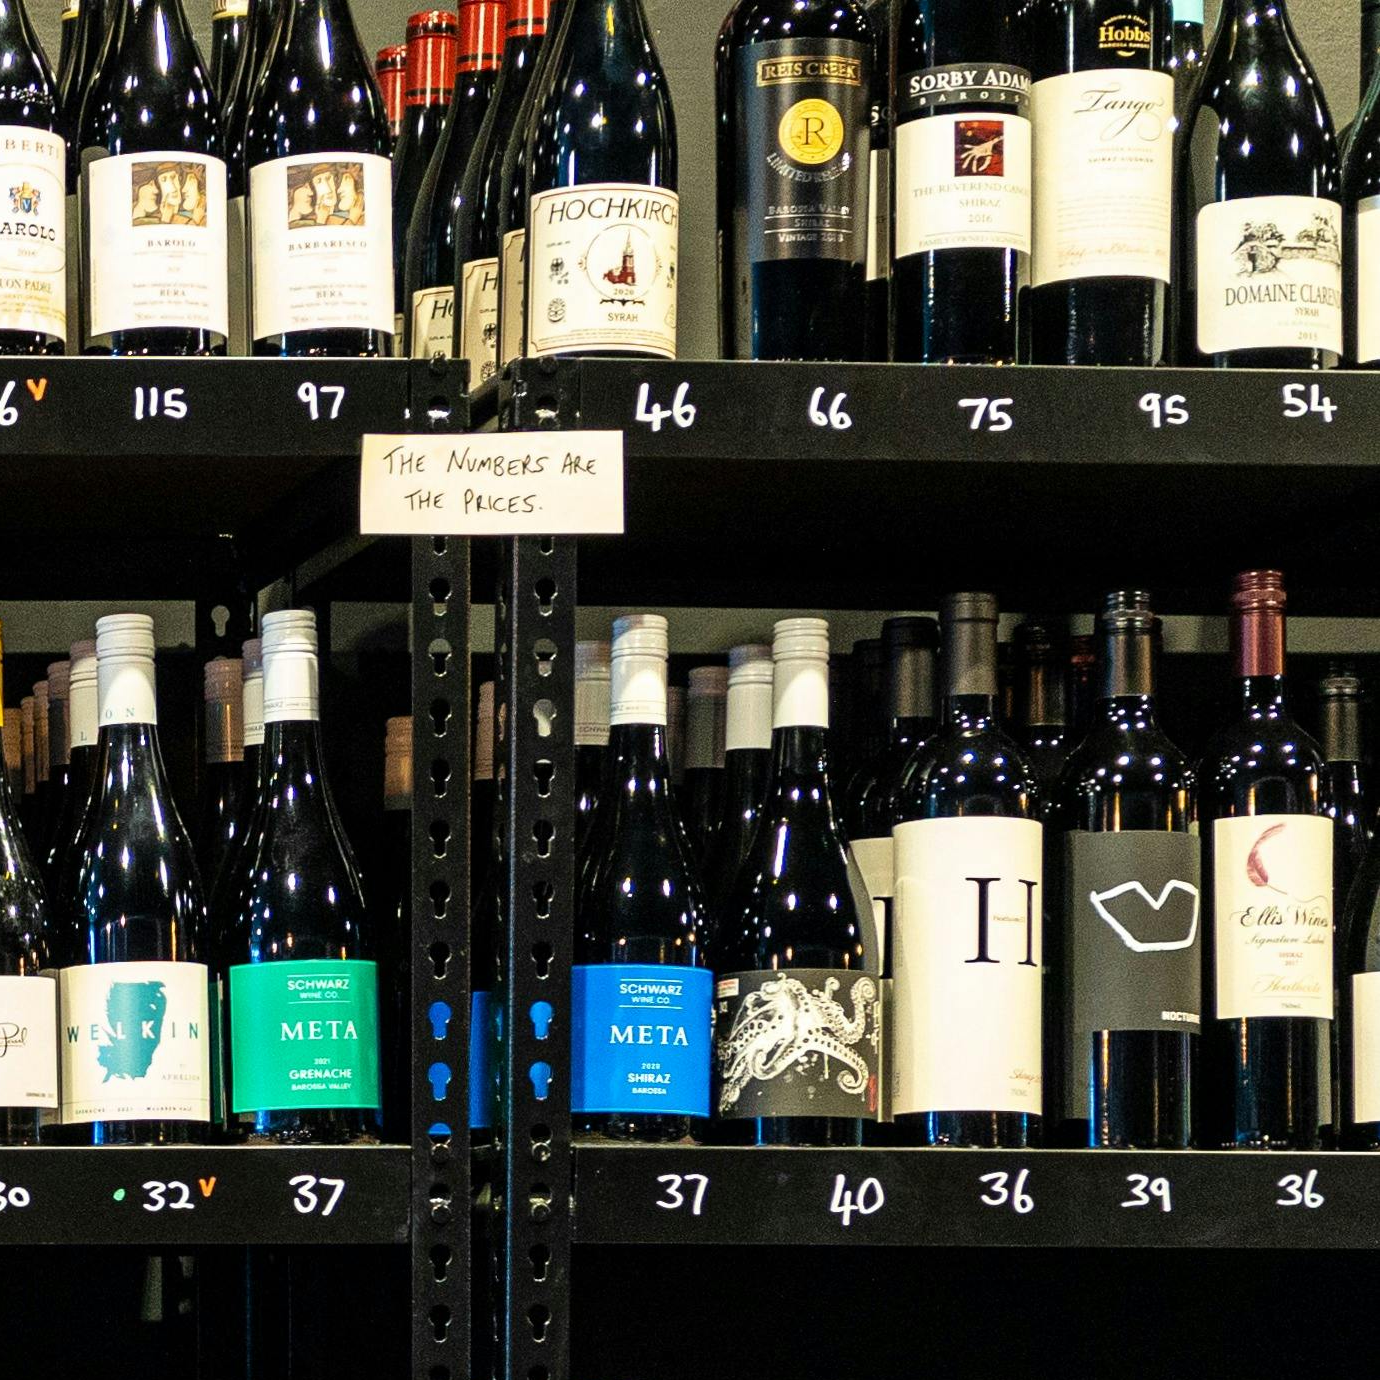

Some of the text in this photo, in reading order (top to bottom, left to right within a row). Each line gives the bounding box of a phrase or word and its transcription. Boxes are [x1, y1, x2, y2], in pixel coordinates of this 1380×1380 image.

[1099, 26, 1151, 44] Hobbs
[765, 62, 857, 79] REIS CREEK
[548, 198, 678, 224] HOCHKIRCH
[960, 199, 1001, 208] SHIRAZ
[608, 313, 638, 322] SYRAH
[134, 386, 188, 421] 115
[296, 381, 345, 421] 97
[634, 381, 697, 432] 46
[807, 386, 853, 430] 66
[957, 397, 1014, 432] 75
[1138, 392, 1190, 429] 95
[1282, 382, 1338, 423] 54
[384, 446, 597, 476] THE NUMBERS ARE
[405, 489, 443, 510] THE
[67, 1021, 200, 1043] WELKIN
[281, 1020, 359, 1041] META
[610, 1025, 689, 1047] META
[290, 1068, 352, 1080] GRENACHE
[628, 1073, 670, 1084] SHIRAZ
[141, 1180, 195, 1212] 32
[288, 1174, 346, 1216] 37
[655, 1173, 709, 1216] 37
[829, 1173, 885, 1226] 40
[978, 1168, 1035, 1214] 36
[1120, 1173, 1172, 1213] 39
[1276, 1168, 1325, 1209] 36
